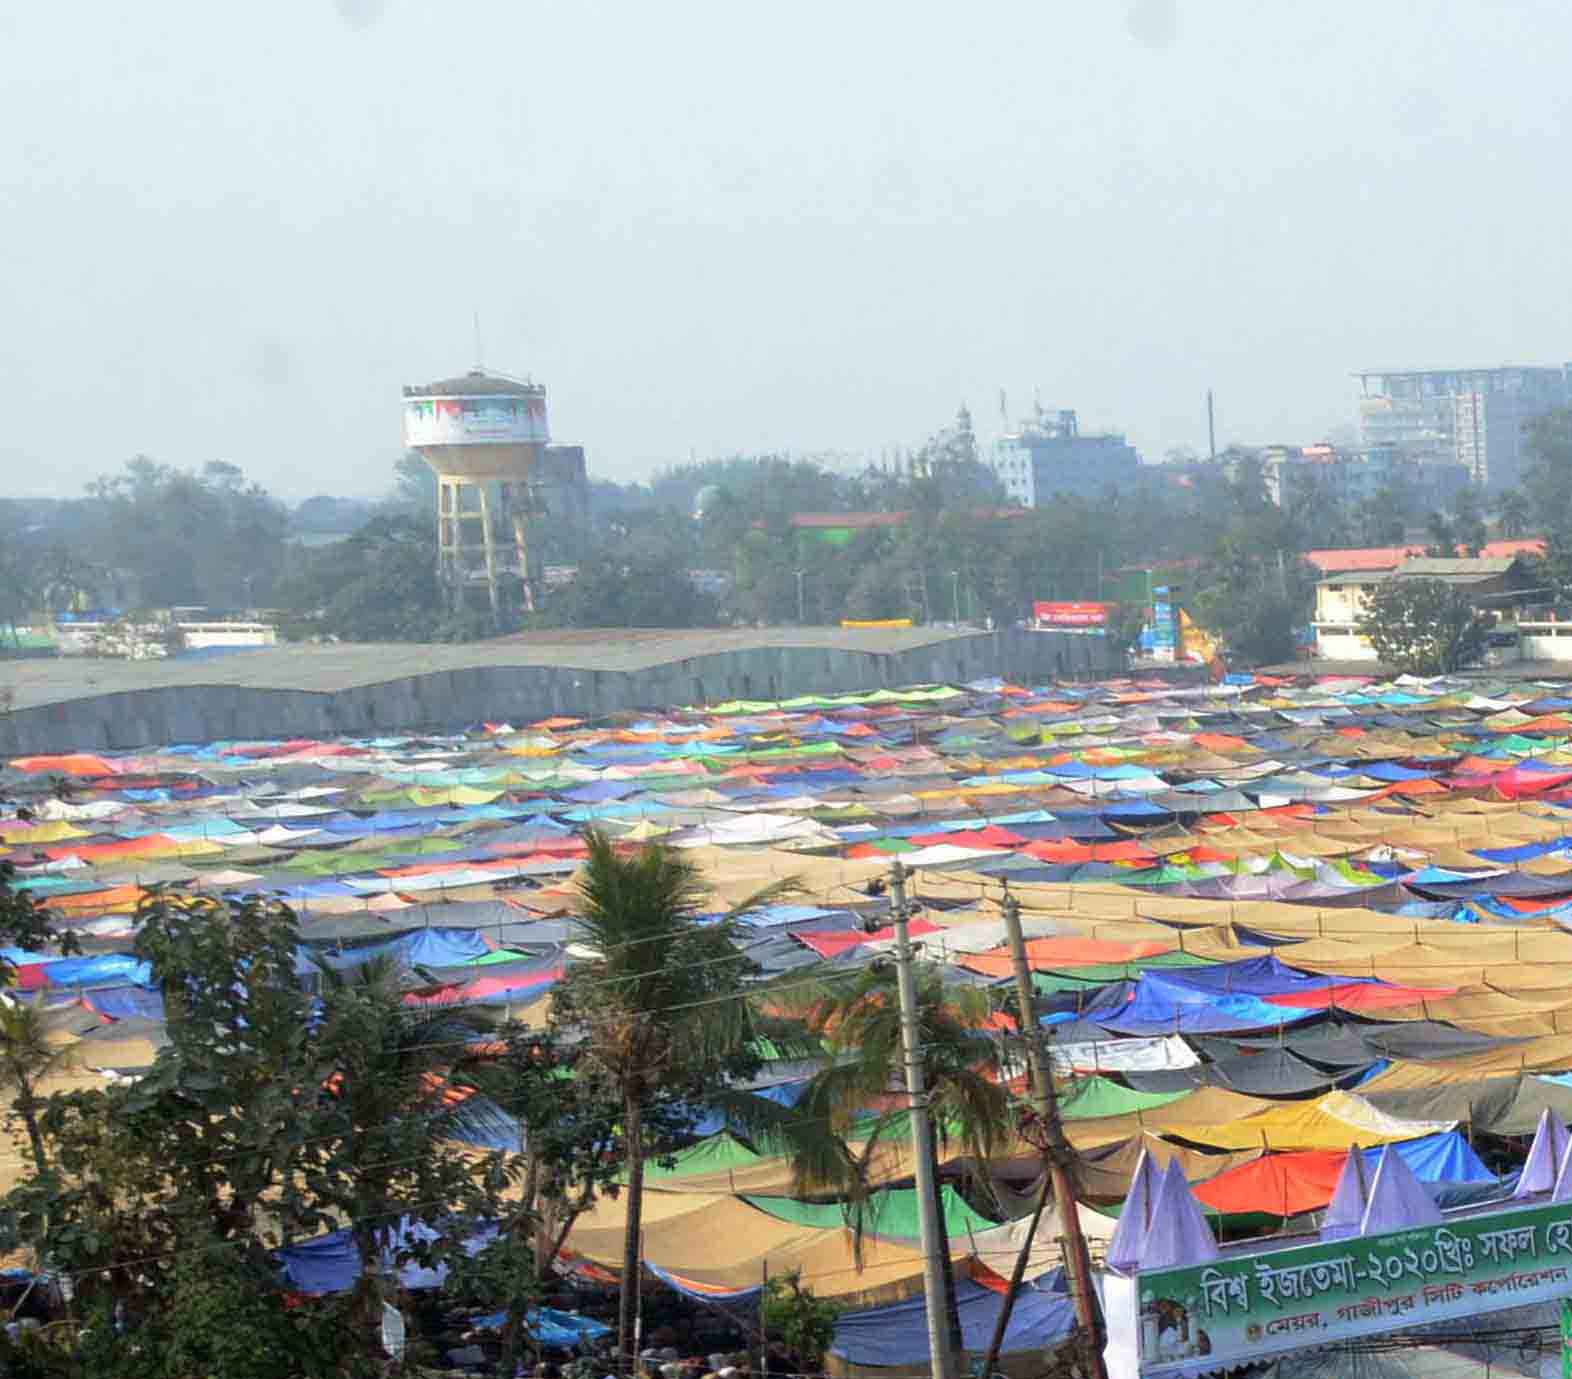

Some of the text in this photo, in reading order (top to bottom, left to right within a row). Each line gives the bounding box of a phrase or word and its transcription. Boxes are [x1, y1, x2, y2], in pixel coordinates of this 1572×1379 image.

[1201, 1265, 1249, 1318] বিশ্ব
[1479, 1222, 1536, 1264] সফল
[1336, 1290, 1416, 1325] গাজীপুর
[1420, 1281, 1465, 1309] সিটি
